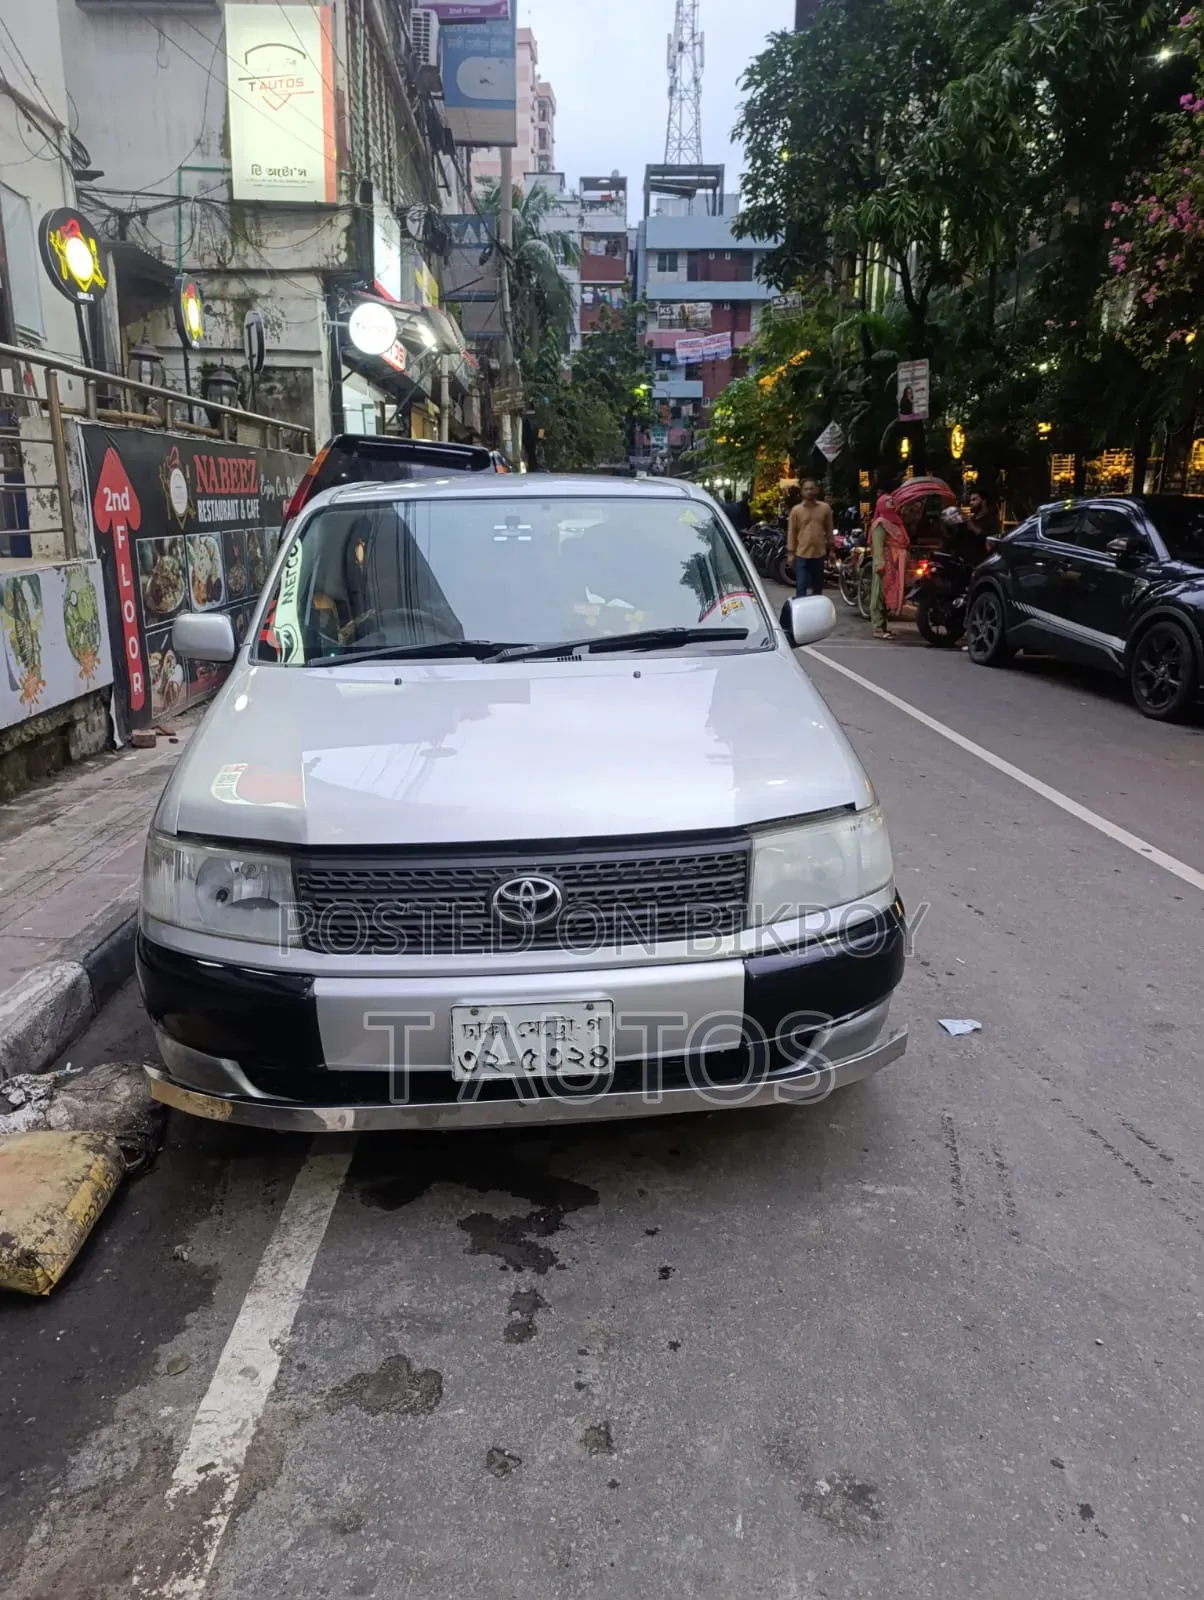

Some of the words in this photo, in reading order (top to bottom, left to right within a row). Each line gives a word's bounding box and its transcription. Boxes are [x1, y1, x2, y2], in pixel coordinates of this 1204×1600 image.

[248, 82, 256, 92] T
[259, 77, 304, 90] AUTOS
[193, 454, 259, 494] NABEEZ
[103, 486, 131, 512] 2nd
[197, 499, 239, 523] RESTAURANT
[240, 500, 247, 520] &
[116, 525, 143, 693] FLOOR
[461, 1021, 510, 1041] ঢাকা
